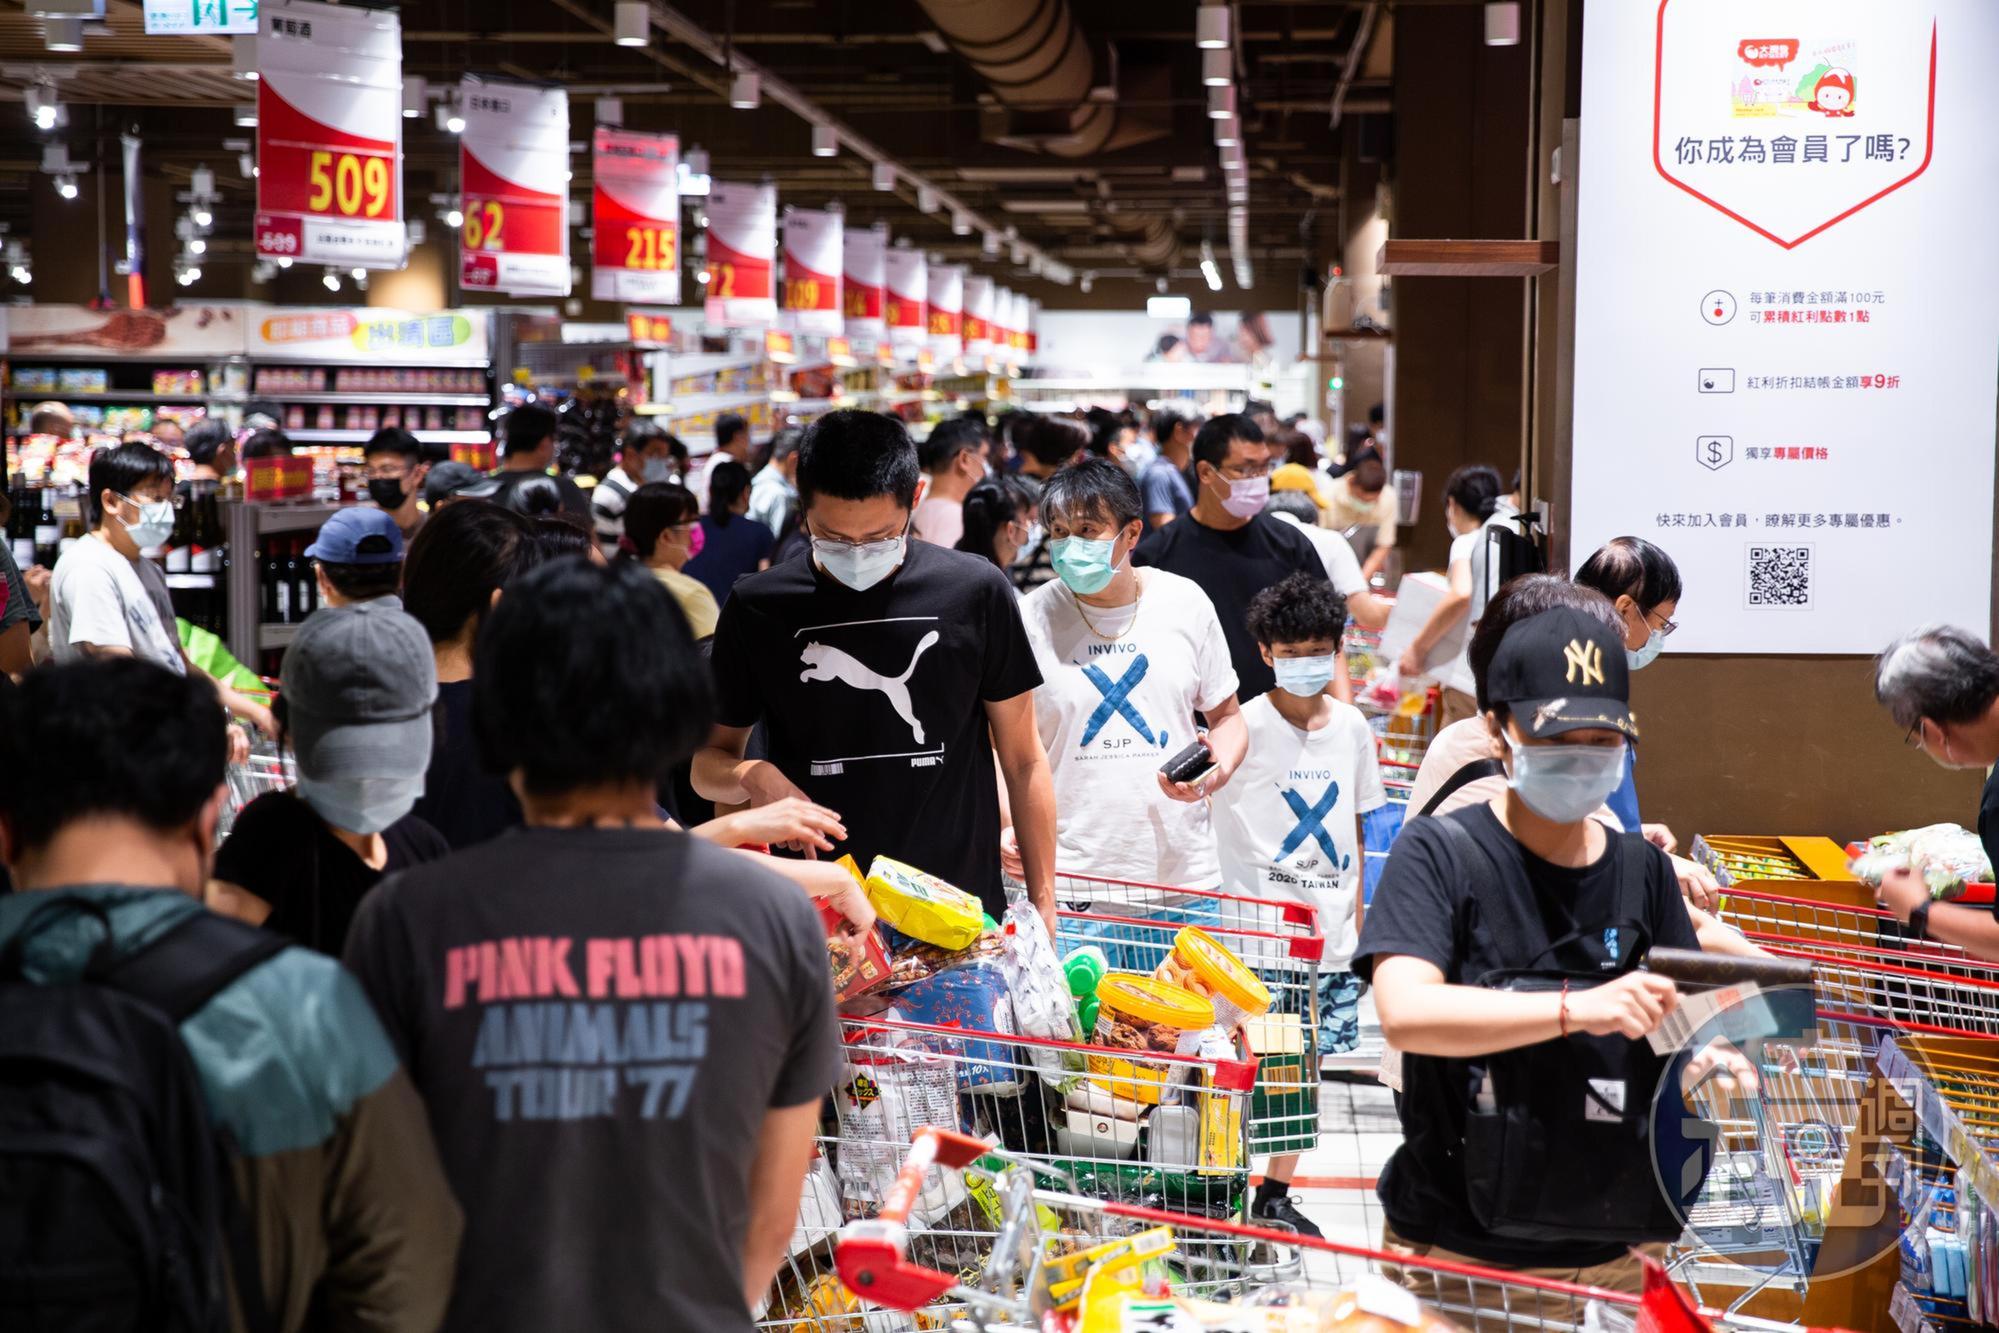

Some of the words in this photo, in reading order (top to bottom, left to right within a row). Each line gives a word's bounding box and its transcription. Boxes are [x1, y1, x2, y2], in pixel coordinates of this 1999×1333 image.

[1675, 134, 1911, 164] 你成為會員了嗎?
[309, 151, 388, 217] 509
[464, 200, 504, 250] 62
[626, 227, 675, 270] 215
[1750, 291, 1885, 304] 每筆消費金額滿100元
[1750, 310, 1870, 323] 可累積紅利點數1點
[1747, 373, 1900, 389] 紅利折扣結帳金額享9折
[1746, 446, 1828, 460] 獨享專屬價格
[1088, 643, 1137, 655] INVIVO
[1563, 639, 1604, 686] NY
[1103, 738, 1132, 749] SJP
[911, 757, 936, 767] PUMA
[1289, 770, 1330, 780] INVIVO
[1295, 859, 1319, 870] SJP
[1301, 880, 1339, 889] TAIWAN
[443, 936, 580, 1009] PINK
[586, 934, 747, 998] FLOYD
[472, 1002, 709, 1068] ANIMALS
[485, 1069, 617, 1121] TOUR
